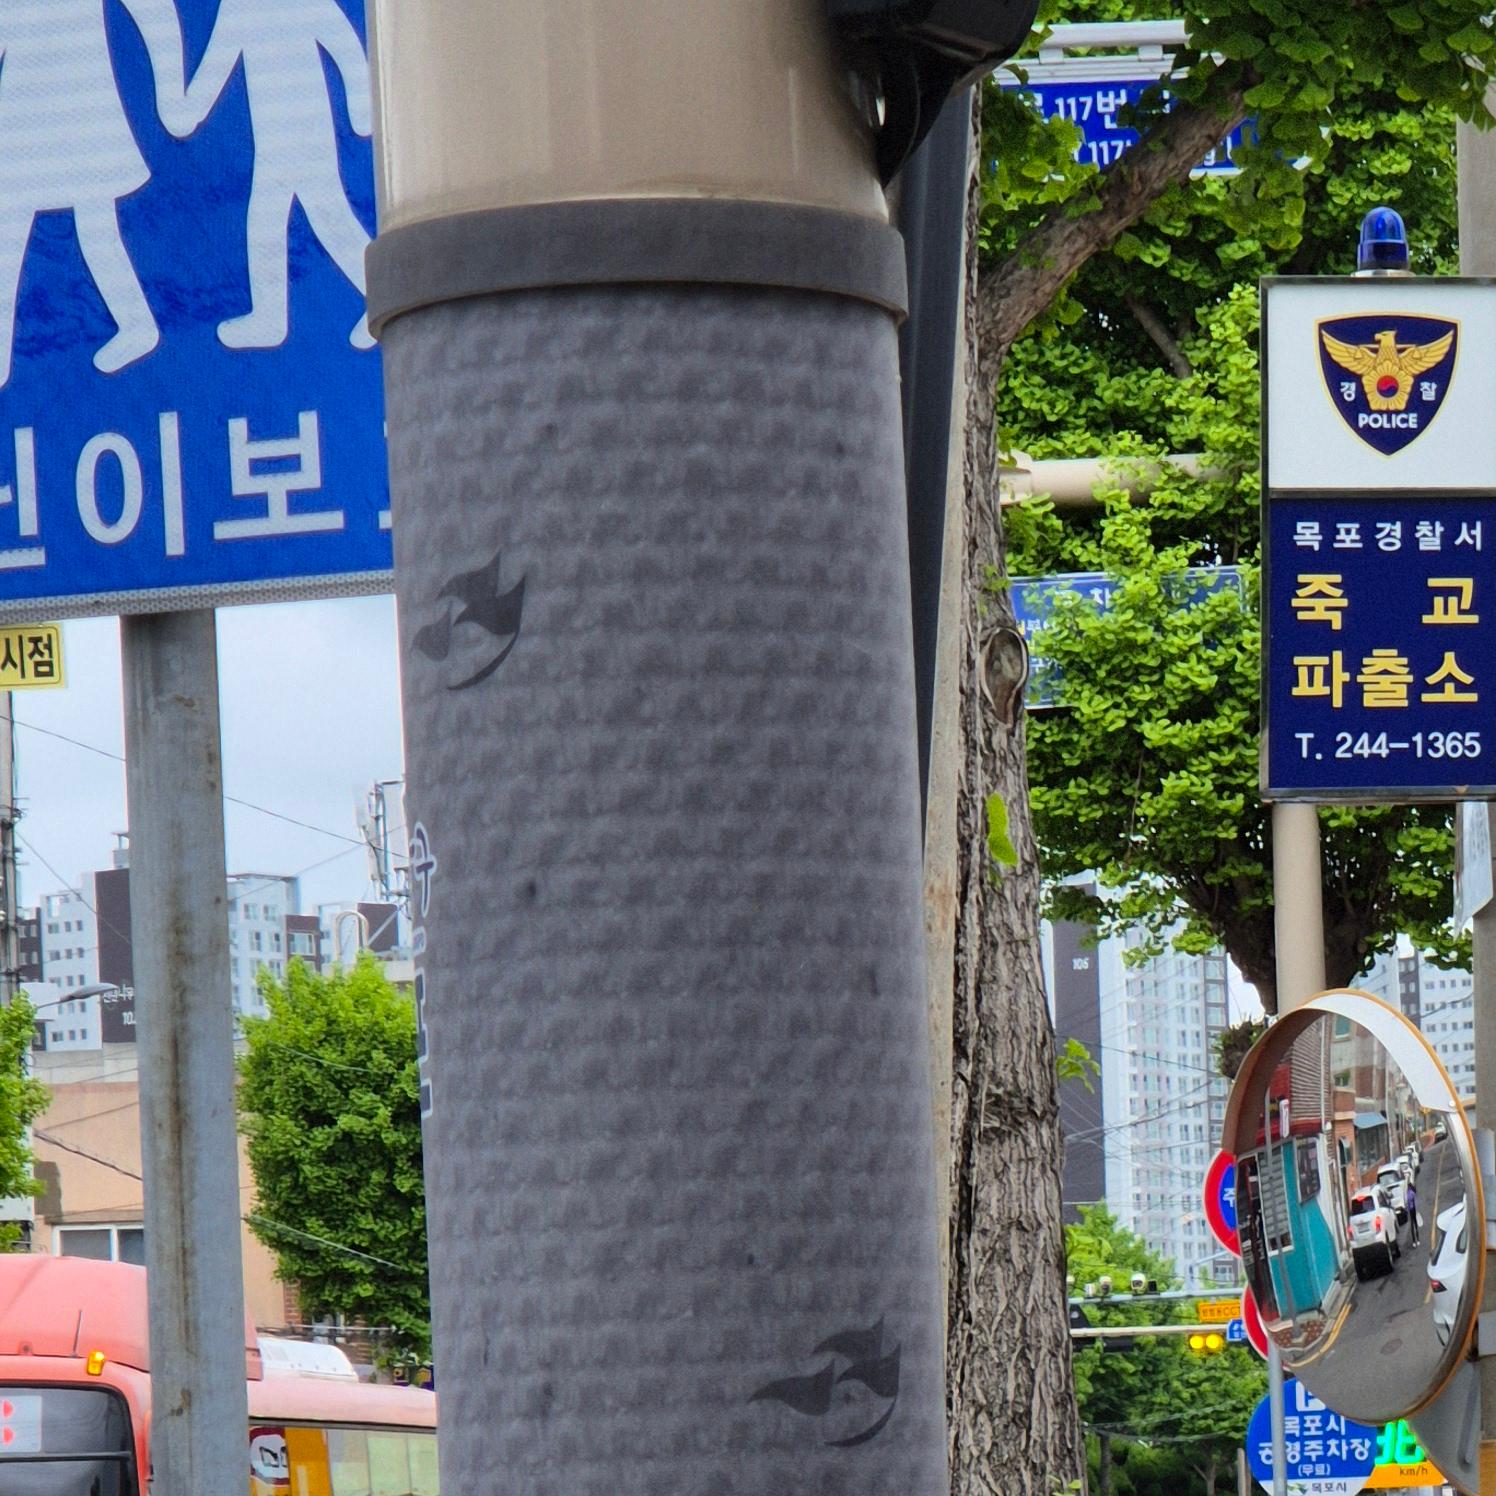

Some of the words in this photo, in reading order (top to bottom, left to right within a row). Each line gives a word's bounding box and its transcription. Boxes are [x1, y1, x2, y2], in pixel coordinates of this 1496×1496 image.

[1358, 413, 1418, 429] POLICE
[0, 410, 392, 568] 이보
[1293, 520, 1482, 551] 목포경찰서
[1291, 649, 1479, 708] 파출소
[1294, 732, 1323, 760] T.
[1335, 732, 1481, 759] 244-1365
[1400, 1465, 1428, 1477] km/h
